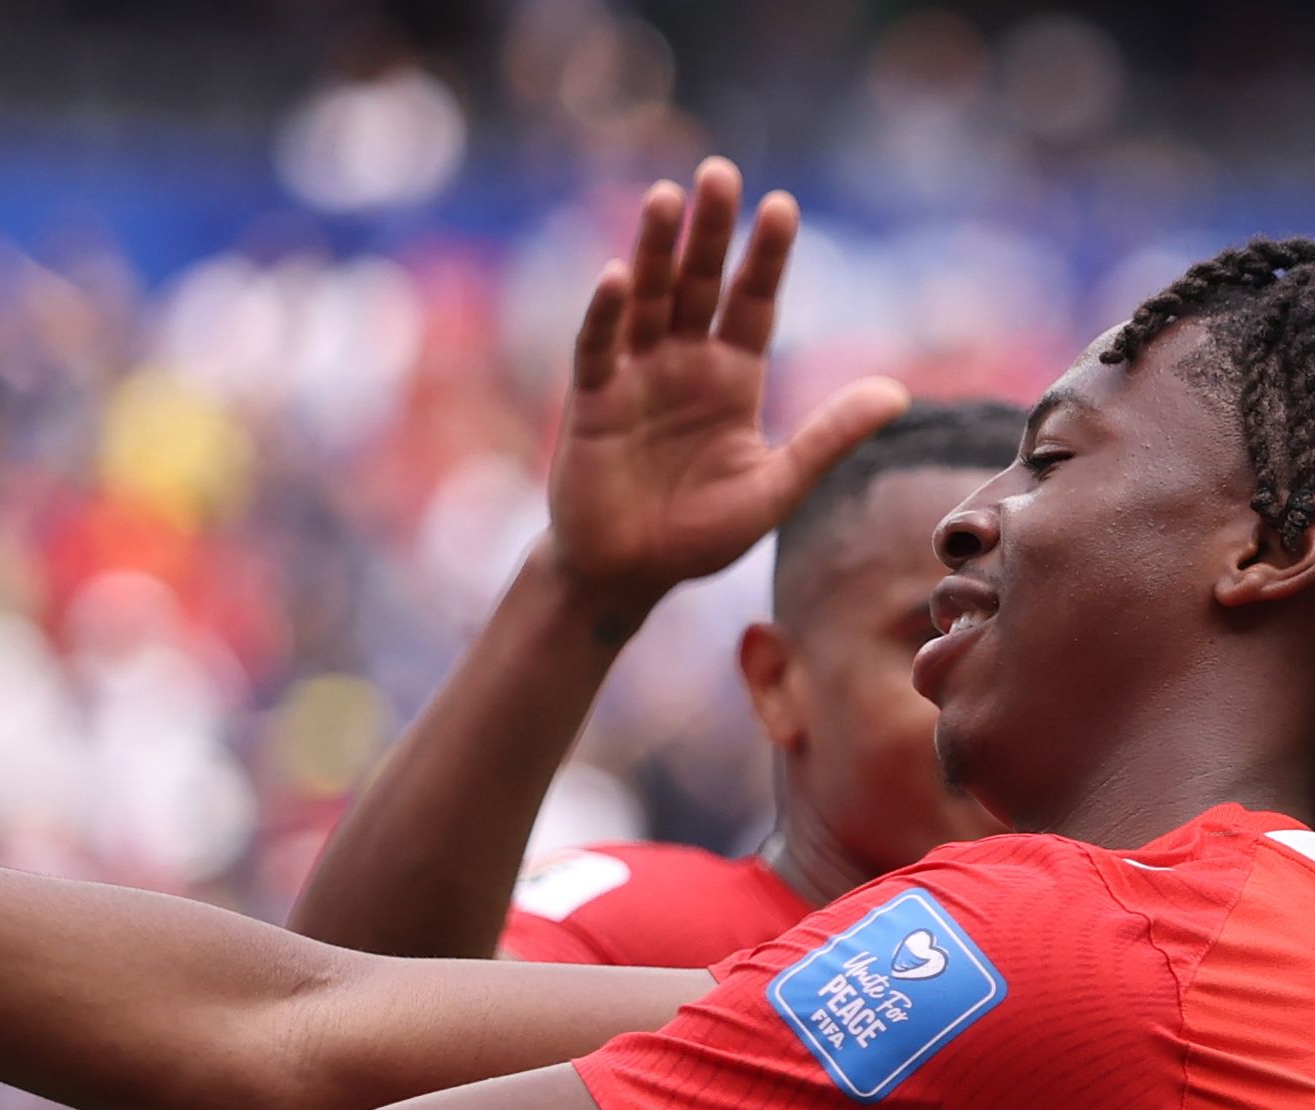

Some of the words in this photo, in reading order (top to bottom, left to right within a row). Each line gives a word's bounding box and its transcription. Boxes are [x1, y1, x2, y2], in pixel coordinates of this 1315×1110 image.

[817, 974, 887, 1048] PEACE
[843, 951, 889, 998] Unite
[877, 989, 913, 1023] For
[810, 1008, 845, 1048] FIFA
